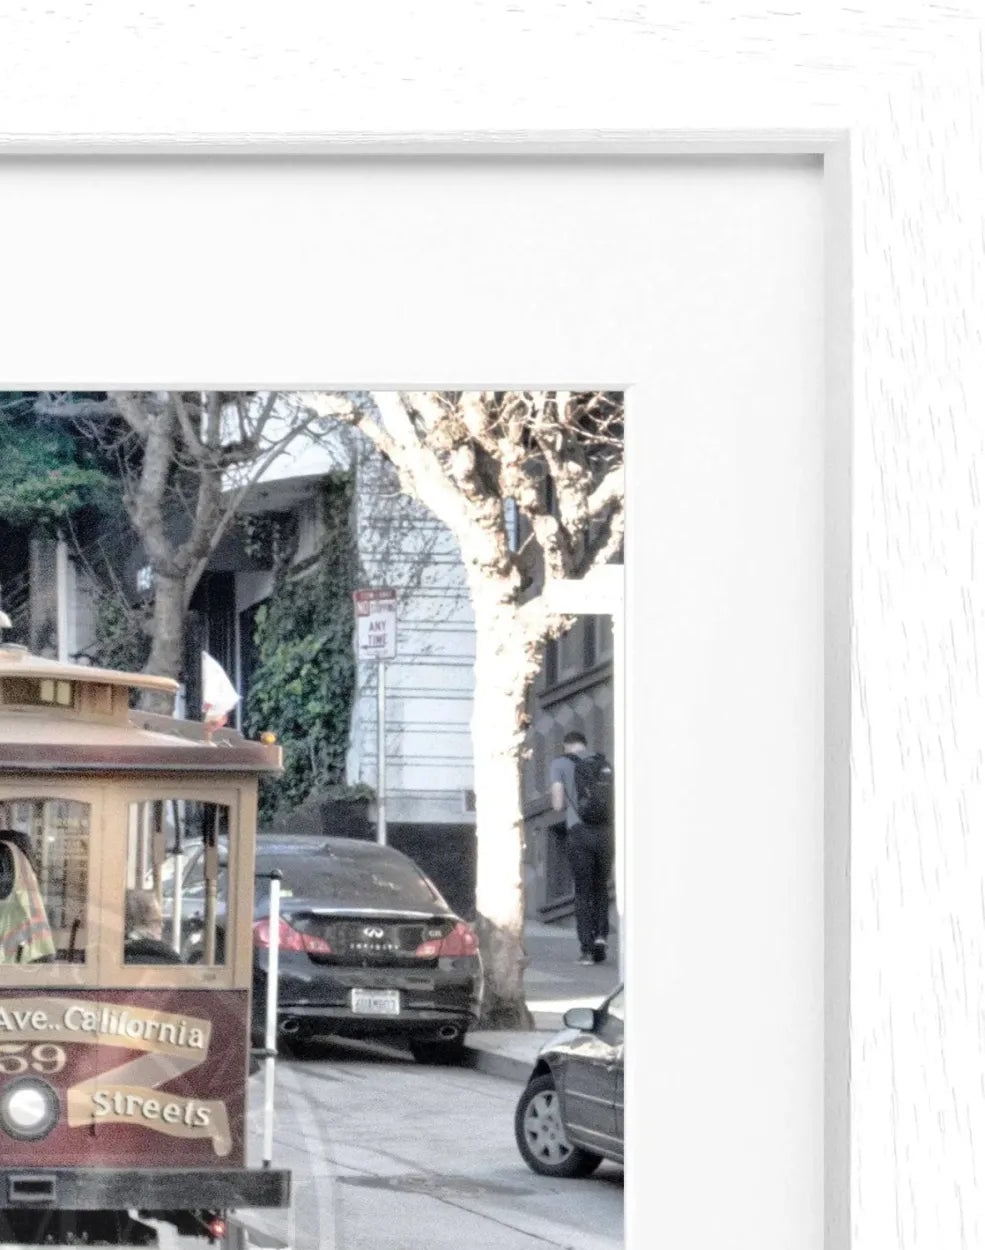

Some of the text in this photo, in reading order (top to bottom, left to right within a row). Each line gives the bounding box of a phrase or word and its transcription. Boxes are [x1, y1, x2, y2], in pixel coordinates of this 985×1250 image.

[368, 620, 386, 631] ANY
[367, 634, 387, 645] TIME
[64, 1005, 204, 1049] California
[91, 1089, 213, 1127] Streets
